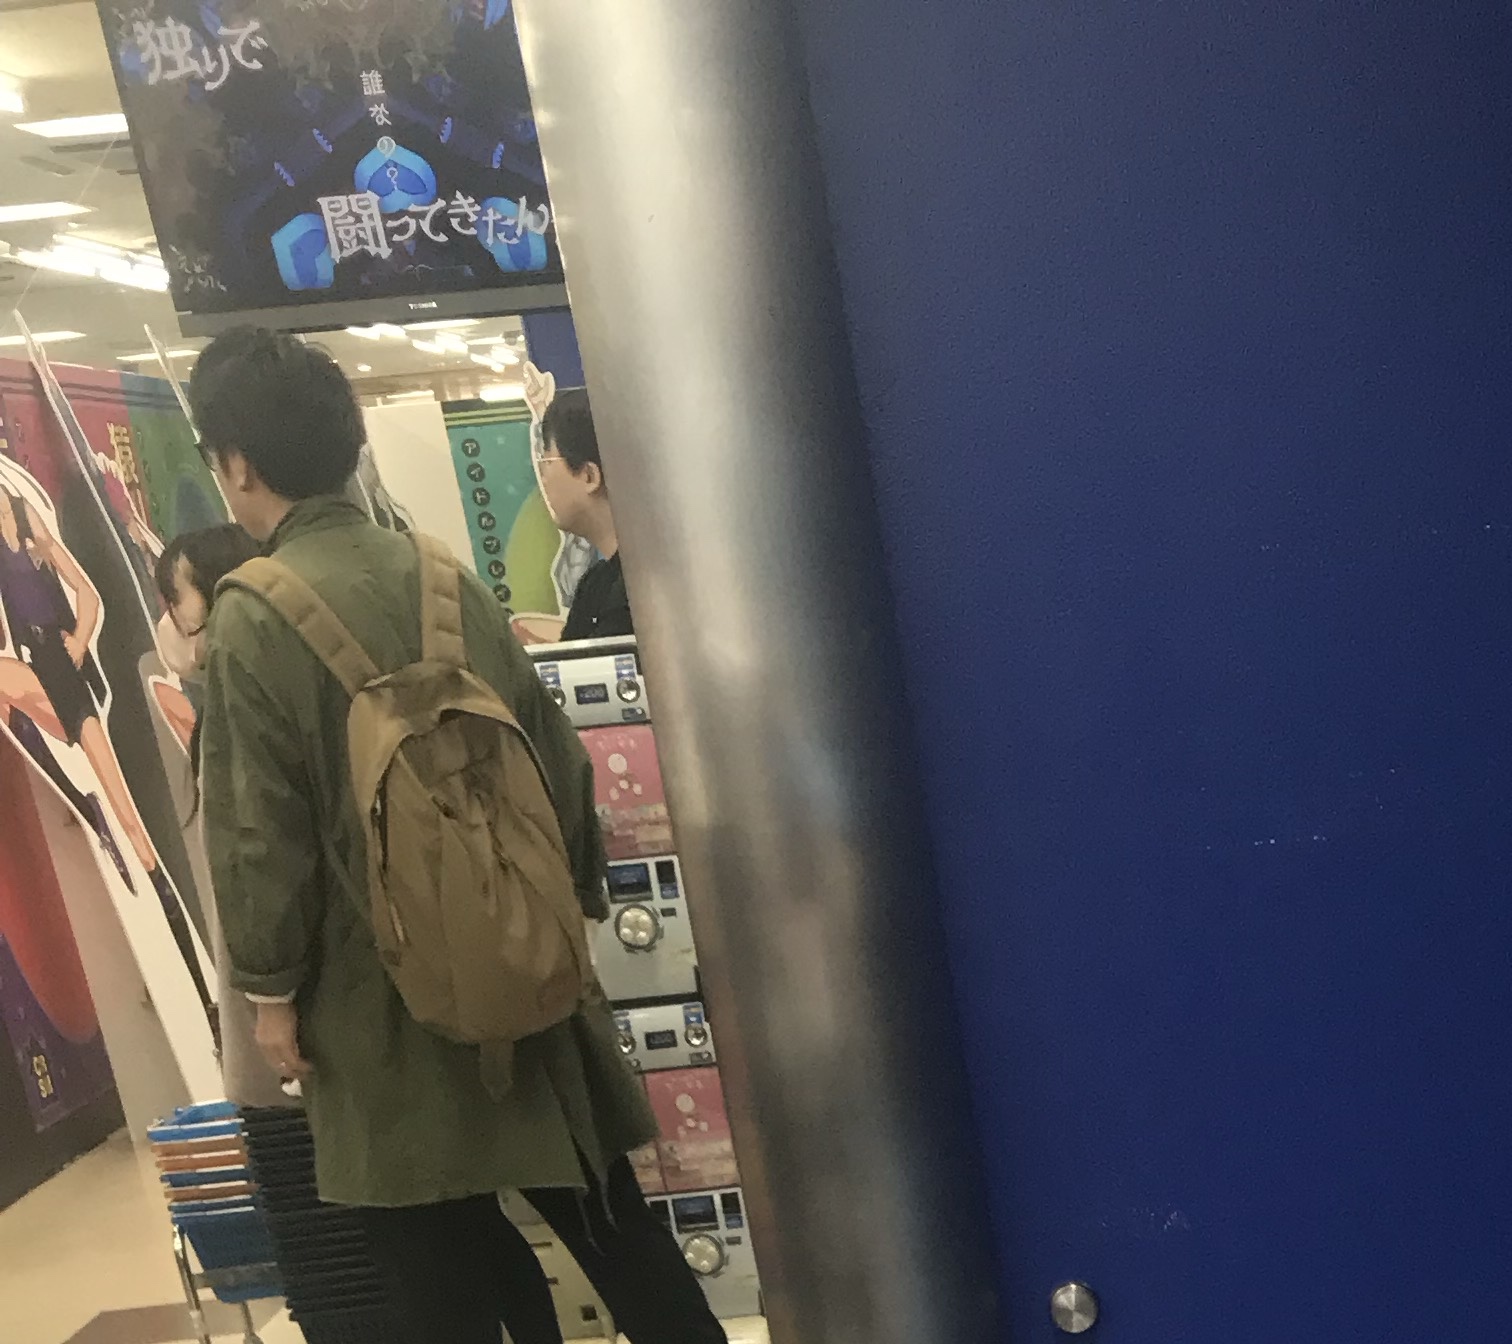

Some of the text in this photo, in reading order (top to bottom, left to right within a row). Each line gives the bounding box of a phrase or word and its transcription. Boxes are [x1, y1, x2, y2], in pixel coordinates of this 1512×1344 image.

[132, 14, 268, 92] 独りで
[317, 189, 555, 264] 闘ってきたん
